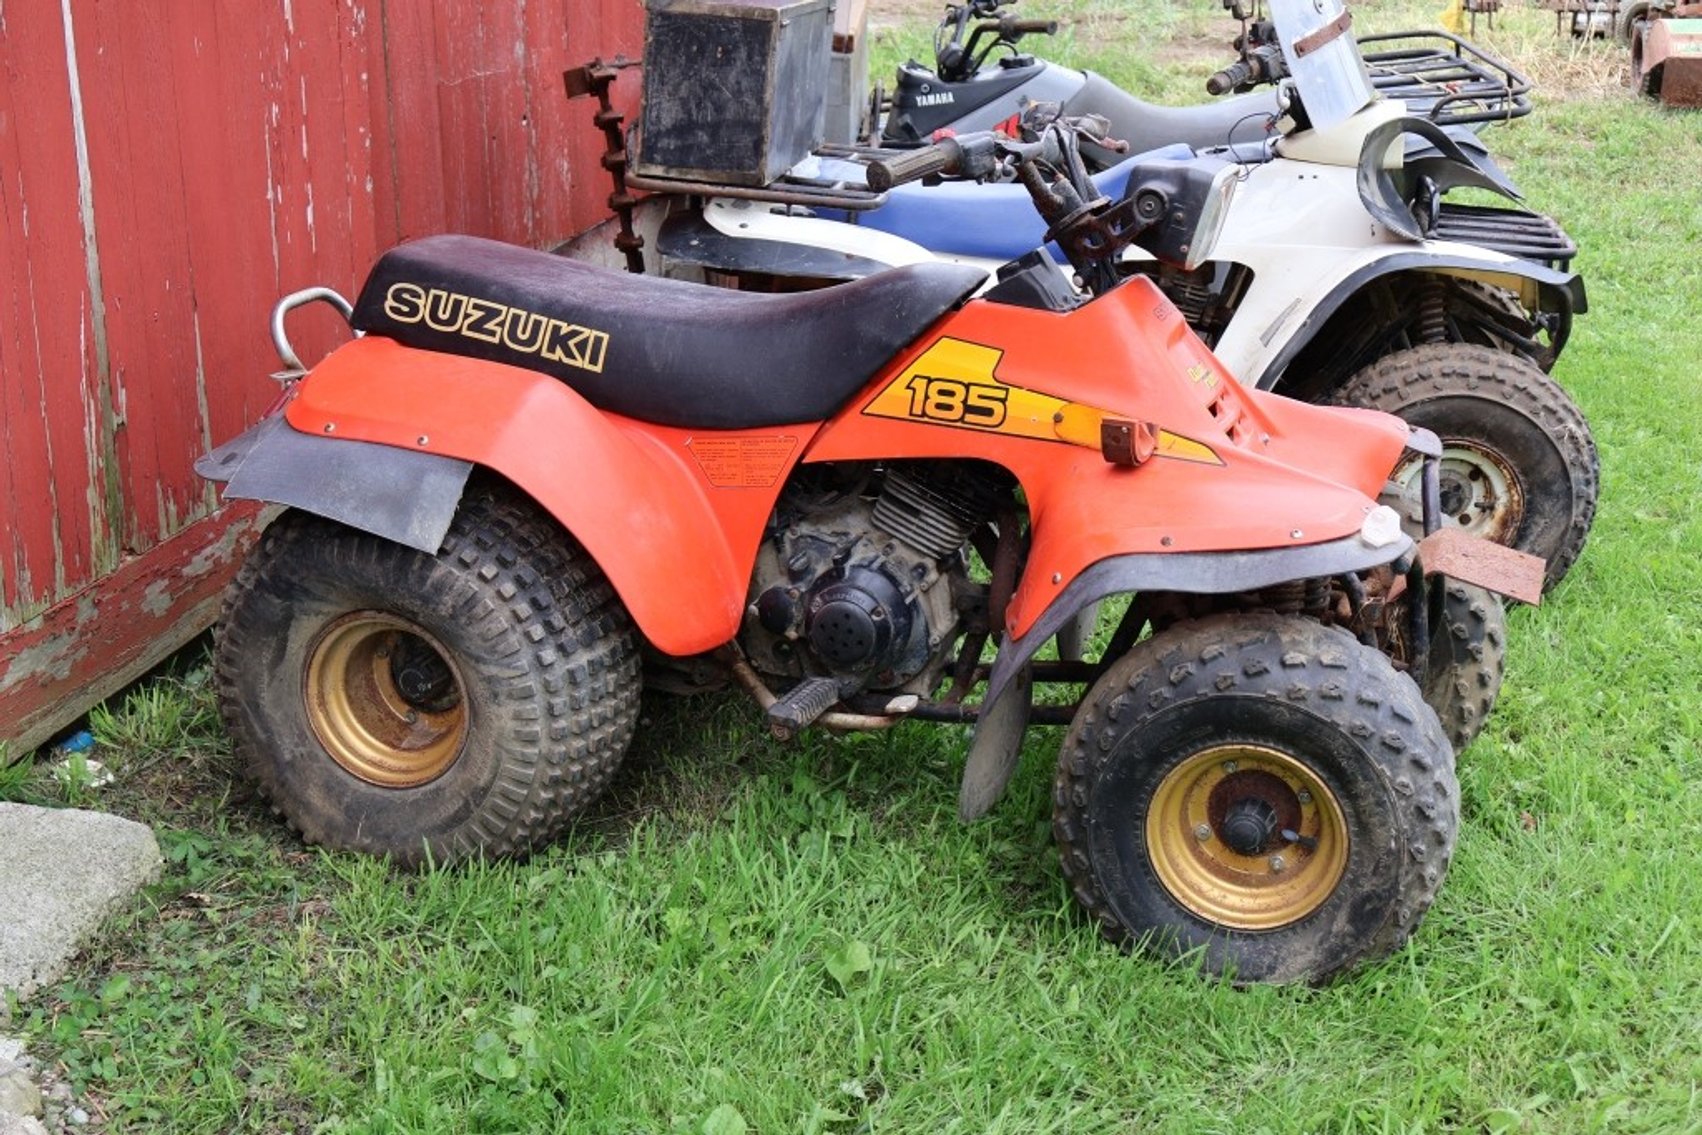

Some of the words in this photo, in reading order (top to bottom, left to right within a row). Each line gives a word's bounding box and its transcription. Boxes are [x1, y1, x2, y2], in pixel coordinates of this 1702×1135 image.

[915, 91, 955, 107] YAMAHA
[384, 282, 610, 373] SUZUKI
[904, 374, 1010, 428] 185
